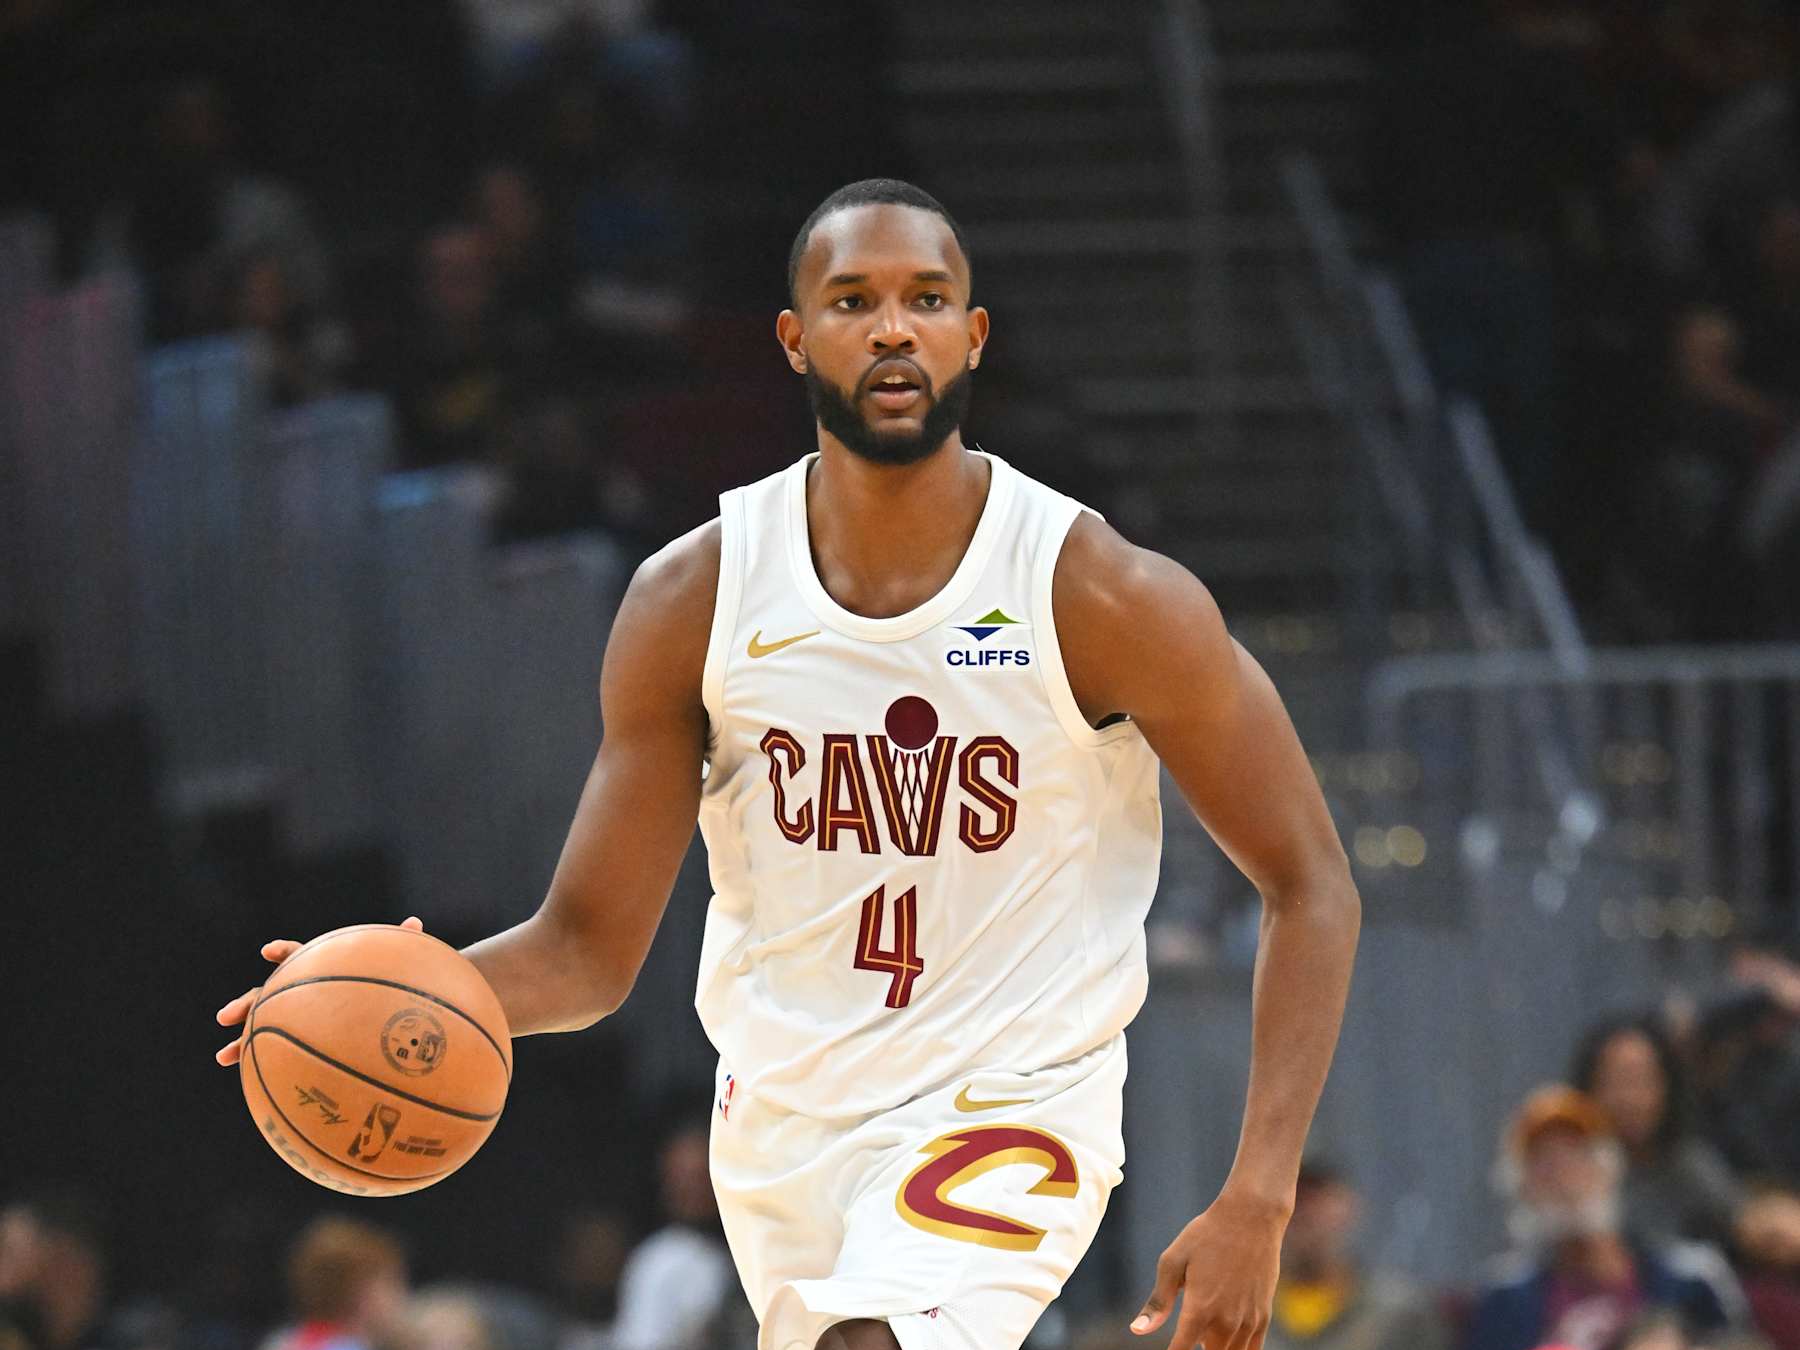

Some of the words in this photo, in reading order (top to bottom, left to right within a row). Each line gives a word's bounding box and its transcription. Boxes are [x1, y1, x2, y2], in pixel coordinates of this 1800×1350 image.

[946, 650, 1030, 667] CLIFFS
[759, 728, 1019, 857] CAVS
[853, 883, 924, 1009] 4
[895, 1123, 1080, 1252] C
